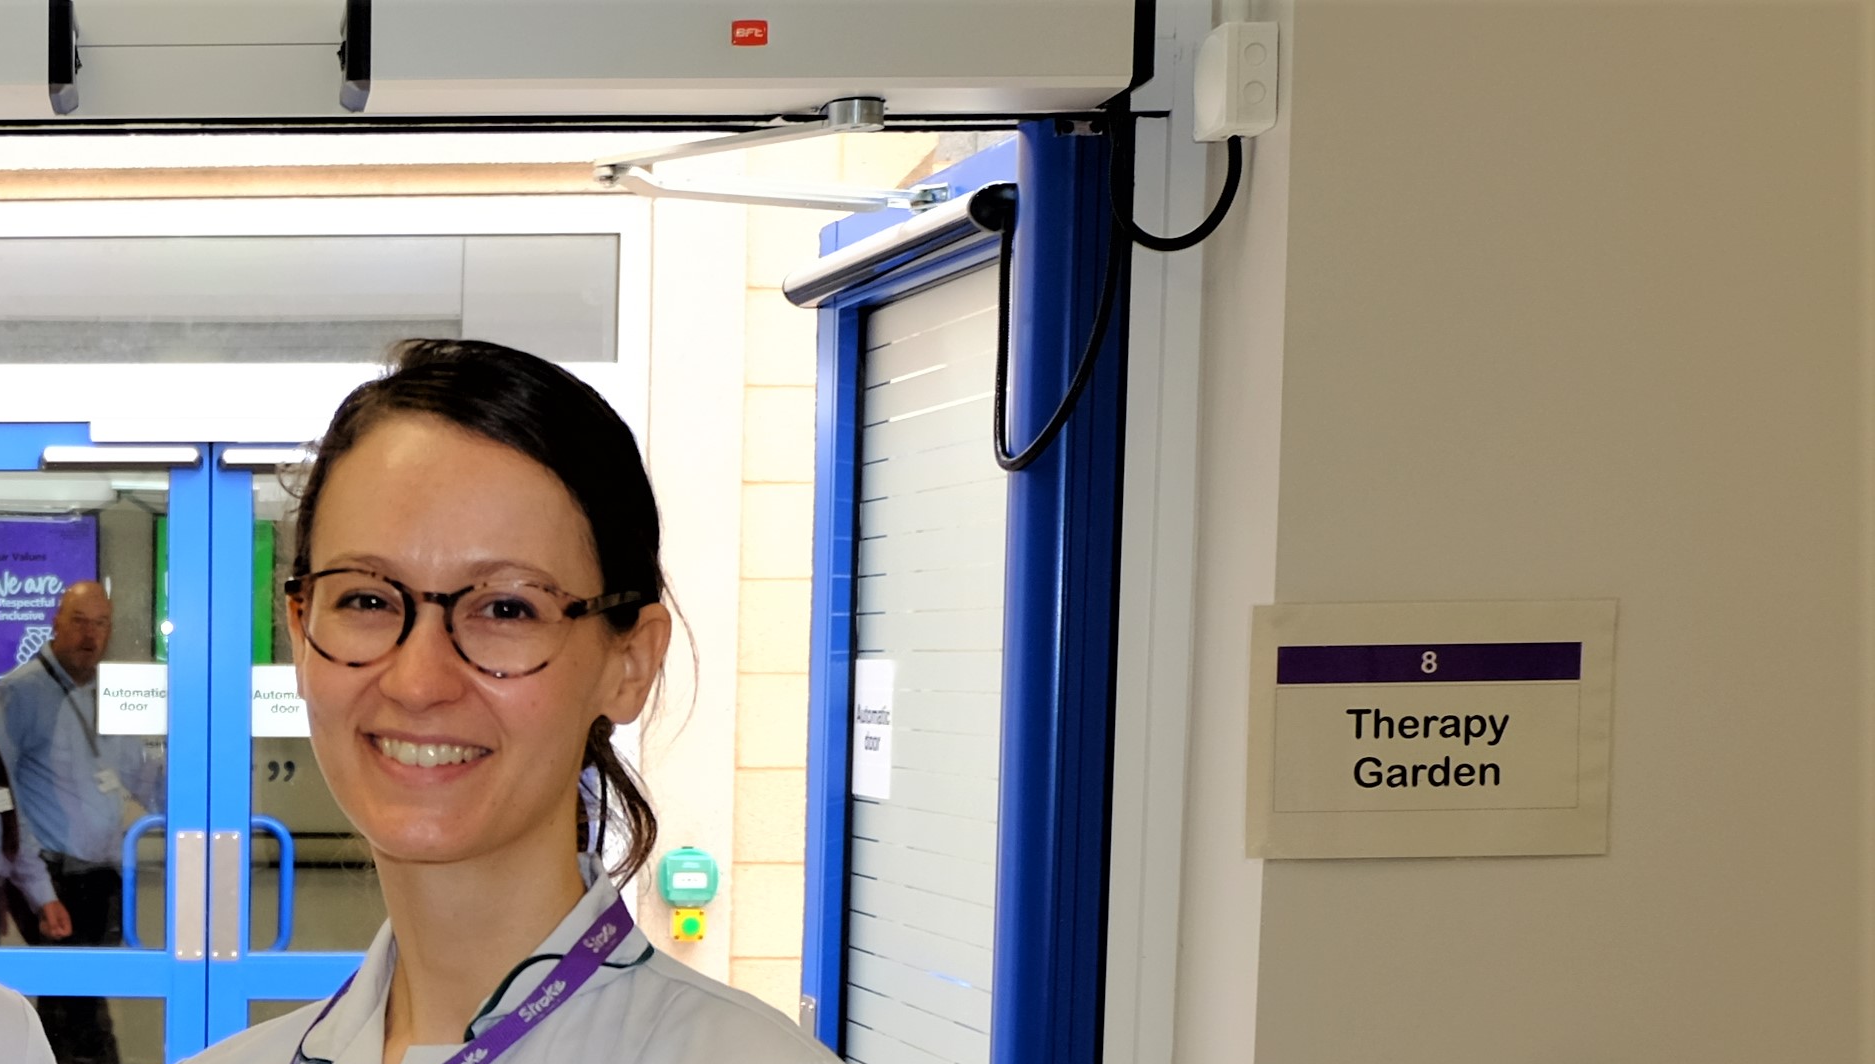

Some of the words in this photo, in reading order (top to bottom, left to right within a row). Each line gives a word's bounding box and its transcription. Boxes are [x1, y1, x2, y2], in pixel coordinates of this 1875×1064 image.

[12, 552, 47, 561] Values
[1420, 650, 1438, 674] 8
[103, 687, 166, 698] Automatic
[119, 702, 149, 711] door
[270, 704, 300, 714] door
[1346, 708, 1509, 746] Therapy
[1354, 756, 1501, 788] Garden
[518, 979, 567, 1022] Stroke
